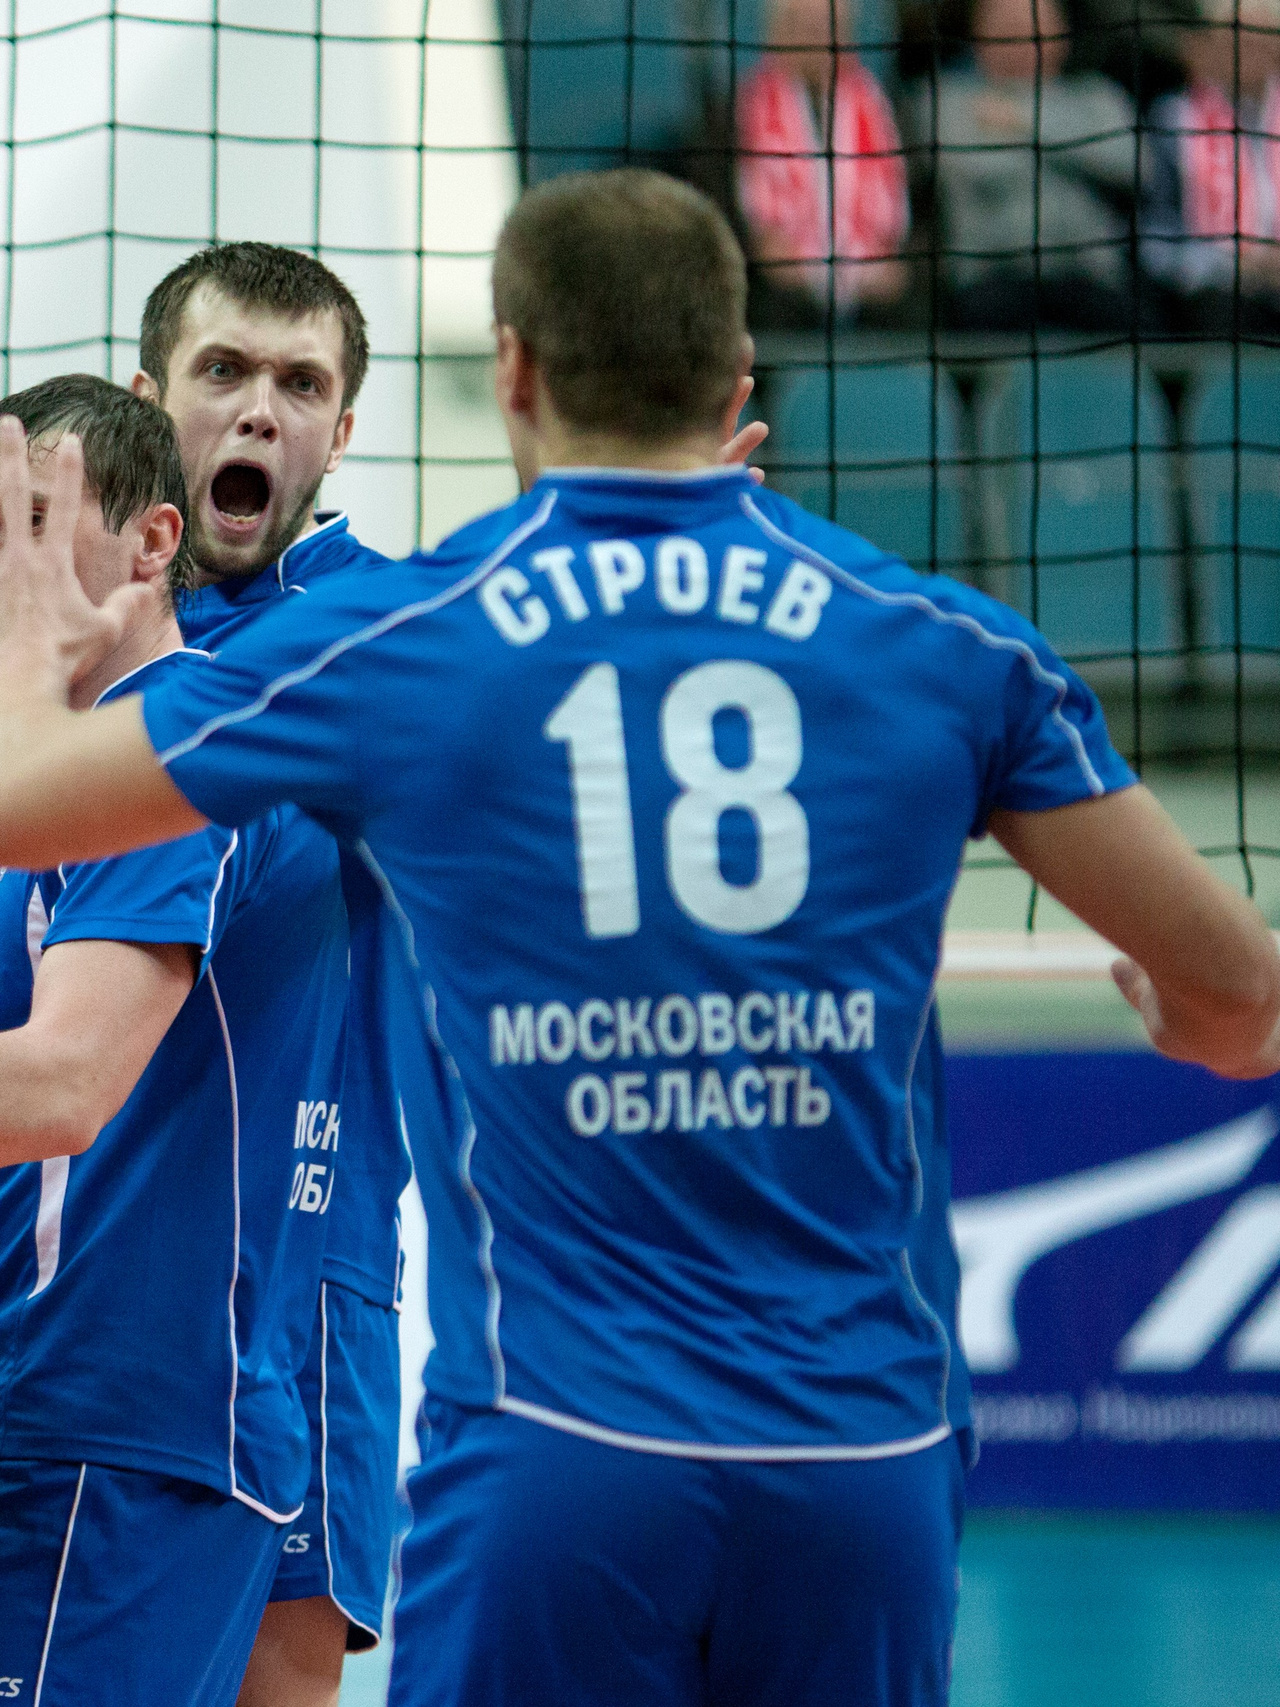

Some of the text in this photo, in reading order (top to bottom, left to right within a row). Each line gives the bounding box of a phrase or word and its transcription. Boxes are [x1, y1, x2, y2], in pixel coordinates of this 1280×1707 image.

[480, 535, 833, 648] СТРОЕВ
[543, 658, 812, 941] 18
[489, 988, 876, 1067] МОСКОВСКАЯ
[565, 1065, 832, 1138] ОБЛАСТЬ
